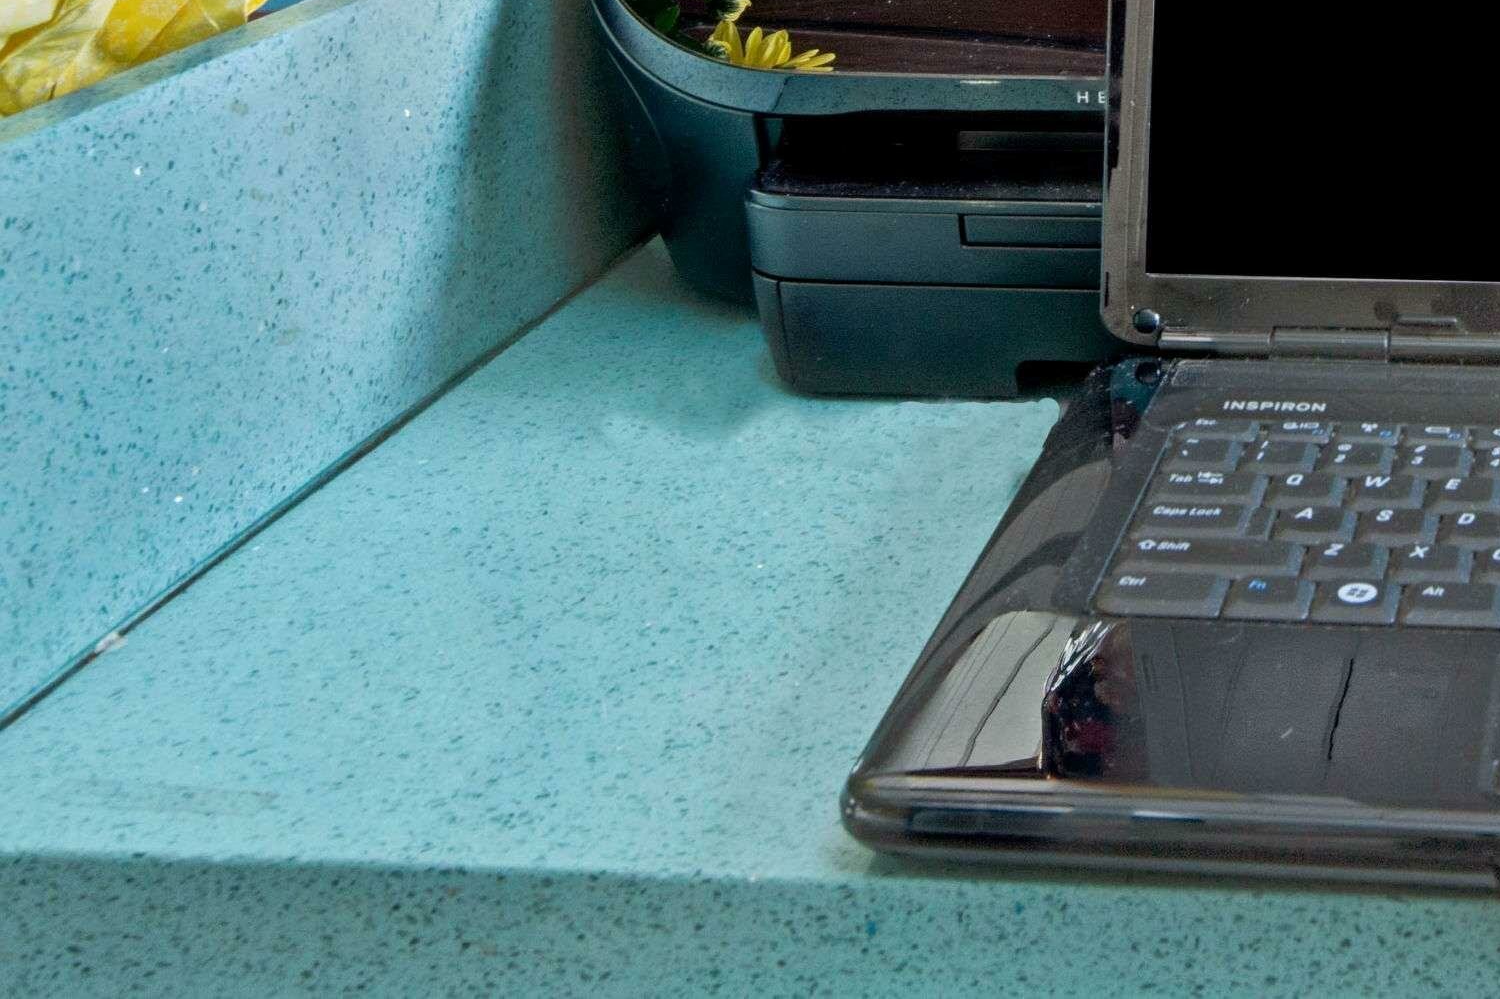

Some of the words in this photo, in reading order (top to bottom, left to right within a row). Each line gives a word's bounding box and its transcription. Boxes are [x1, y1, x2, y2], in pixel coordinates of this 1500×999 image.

[1222, 401, 1327, 413] INSPIRON
[1168, 473, 1193, 483] Tab
[1285, 473, 1304, 486] Q
[1364, 475, 1391, 488] W
[1444, 478, 1462, 491] E
[1152, 505, 1187, 516] Caps
[1189, 507, 1222, 517] Lock
[1294, 506, 1313, 520] A
[1375, 509, 1394, 523] S
[1457, 512, 1476, 526] D
[1156, 541, 1191, 551] Shift
[1323, 542, 1345, 557] Z
[1408, 544, 1430, 559] X
[1117, 575, 1147, 587] Ctrl
[1247, 578, 1267, 590] Fn
[1421, 585, 1445, 598] Alt
